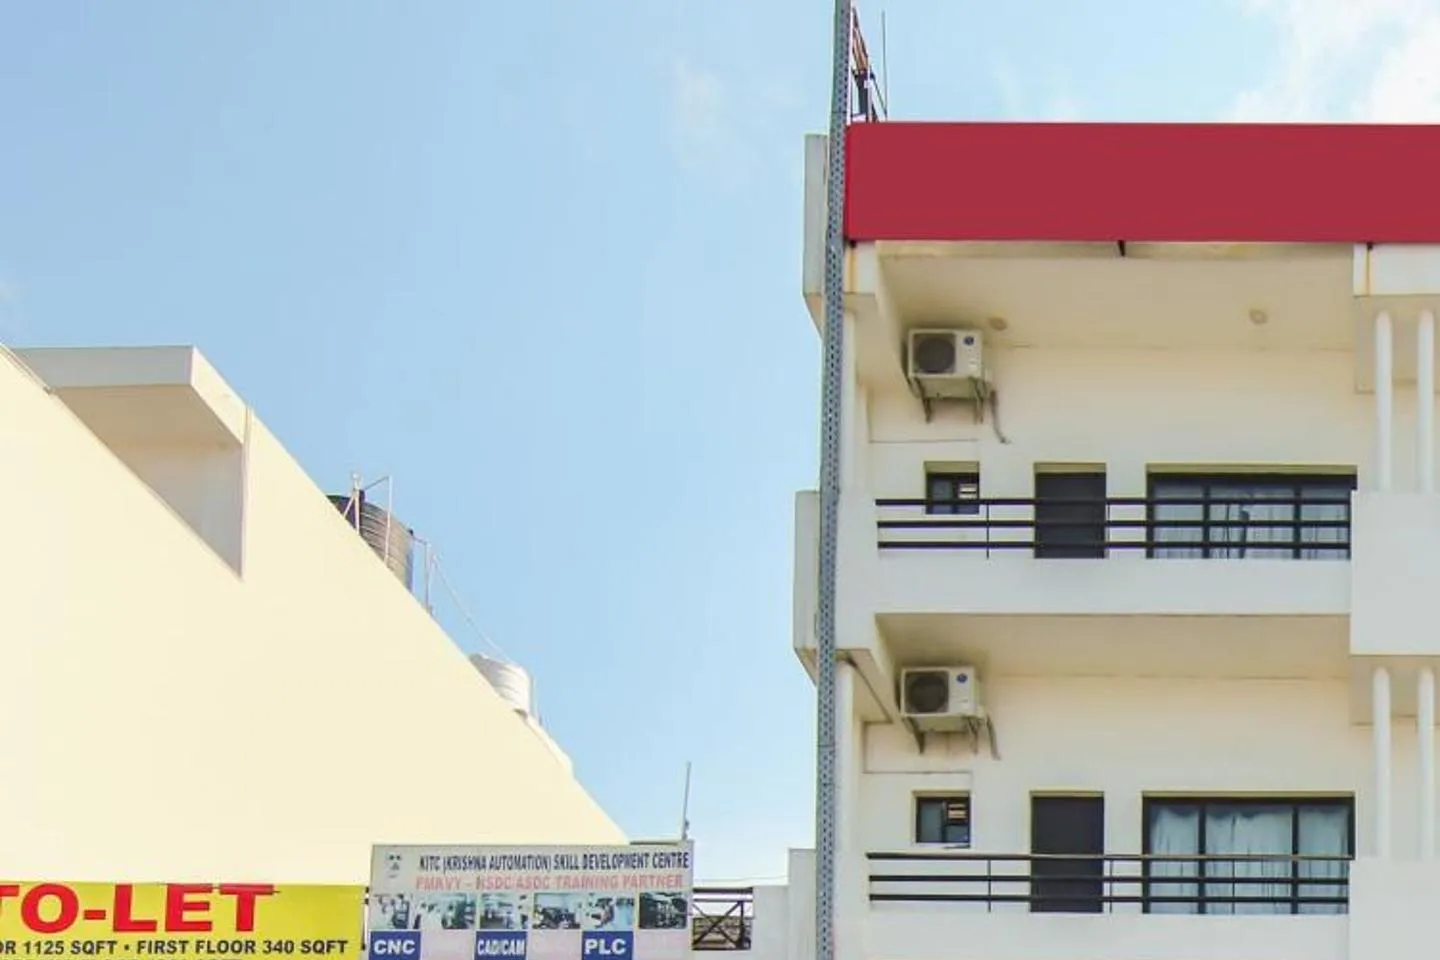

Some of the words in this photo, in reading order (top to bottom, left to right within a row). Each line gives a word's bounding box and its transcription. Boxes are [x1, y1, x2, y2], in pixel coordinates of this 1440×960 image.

[553, 854, 579, 870] SKILL
[583, 853, 649, 870] DEVELOPMENT
[652, 852, 689, 868] CENTRE
[555, 875, 619, 890] TRAINING
[622, 874, 683, 889] PARTNER
[23, 941, 65, 955] 1125
[71, 941, 117, 955] SQFT
[137, 940, 189, 955] FIRST
[195, 940, 256, 955] FLOOR
[263, 940, 294, 955] 340
[301, 940, 348, 955] SQFT
[373, 939, 416, 955] CNC
[583, 938, 627, 955] PLC
